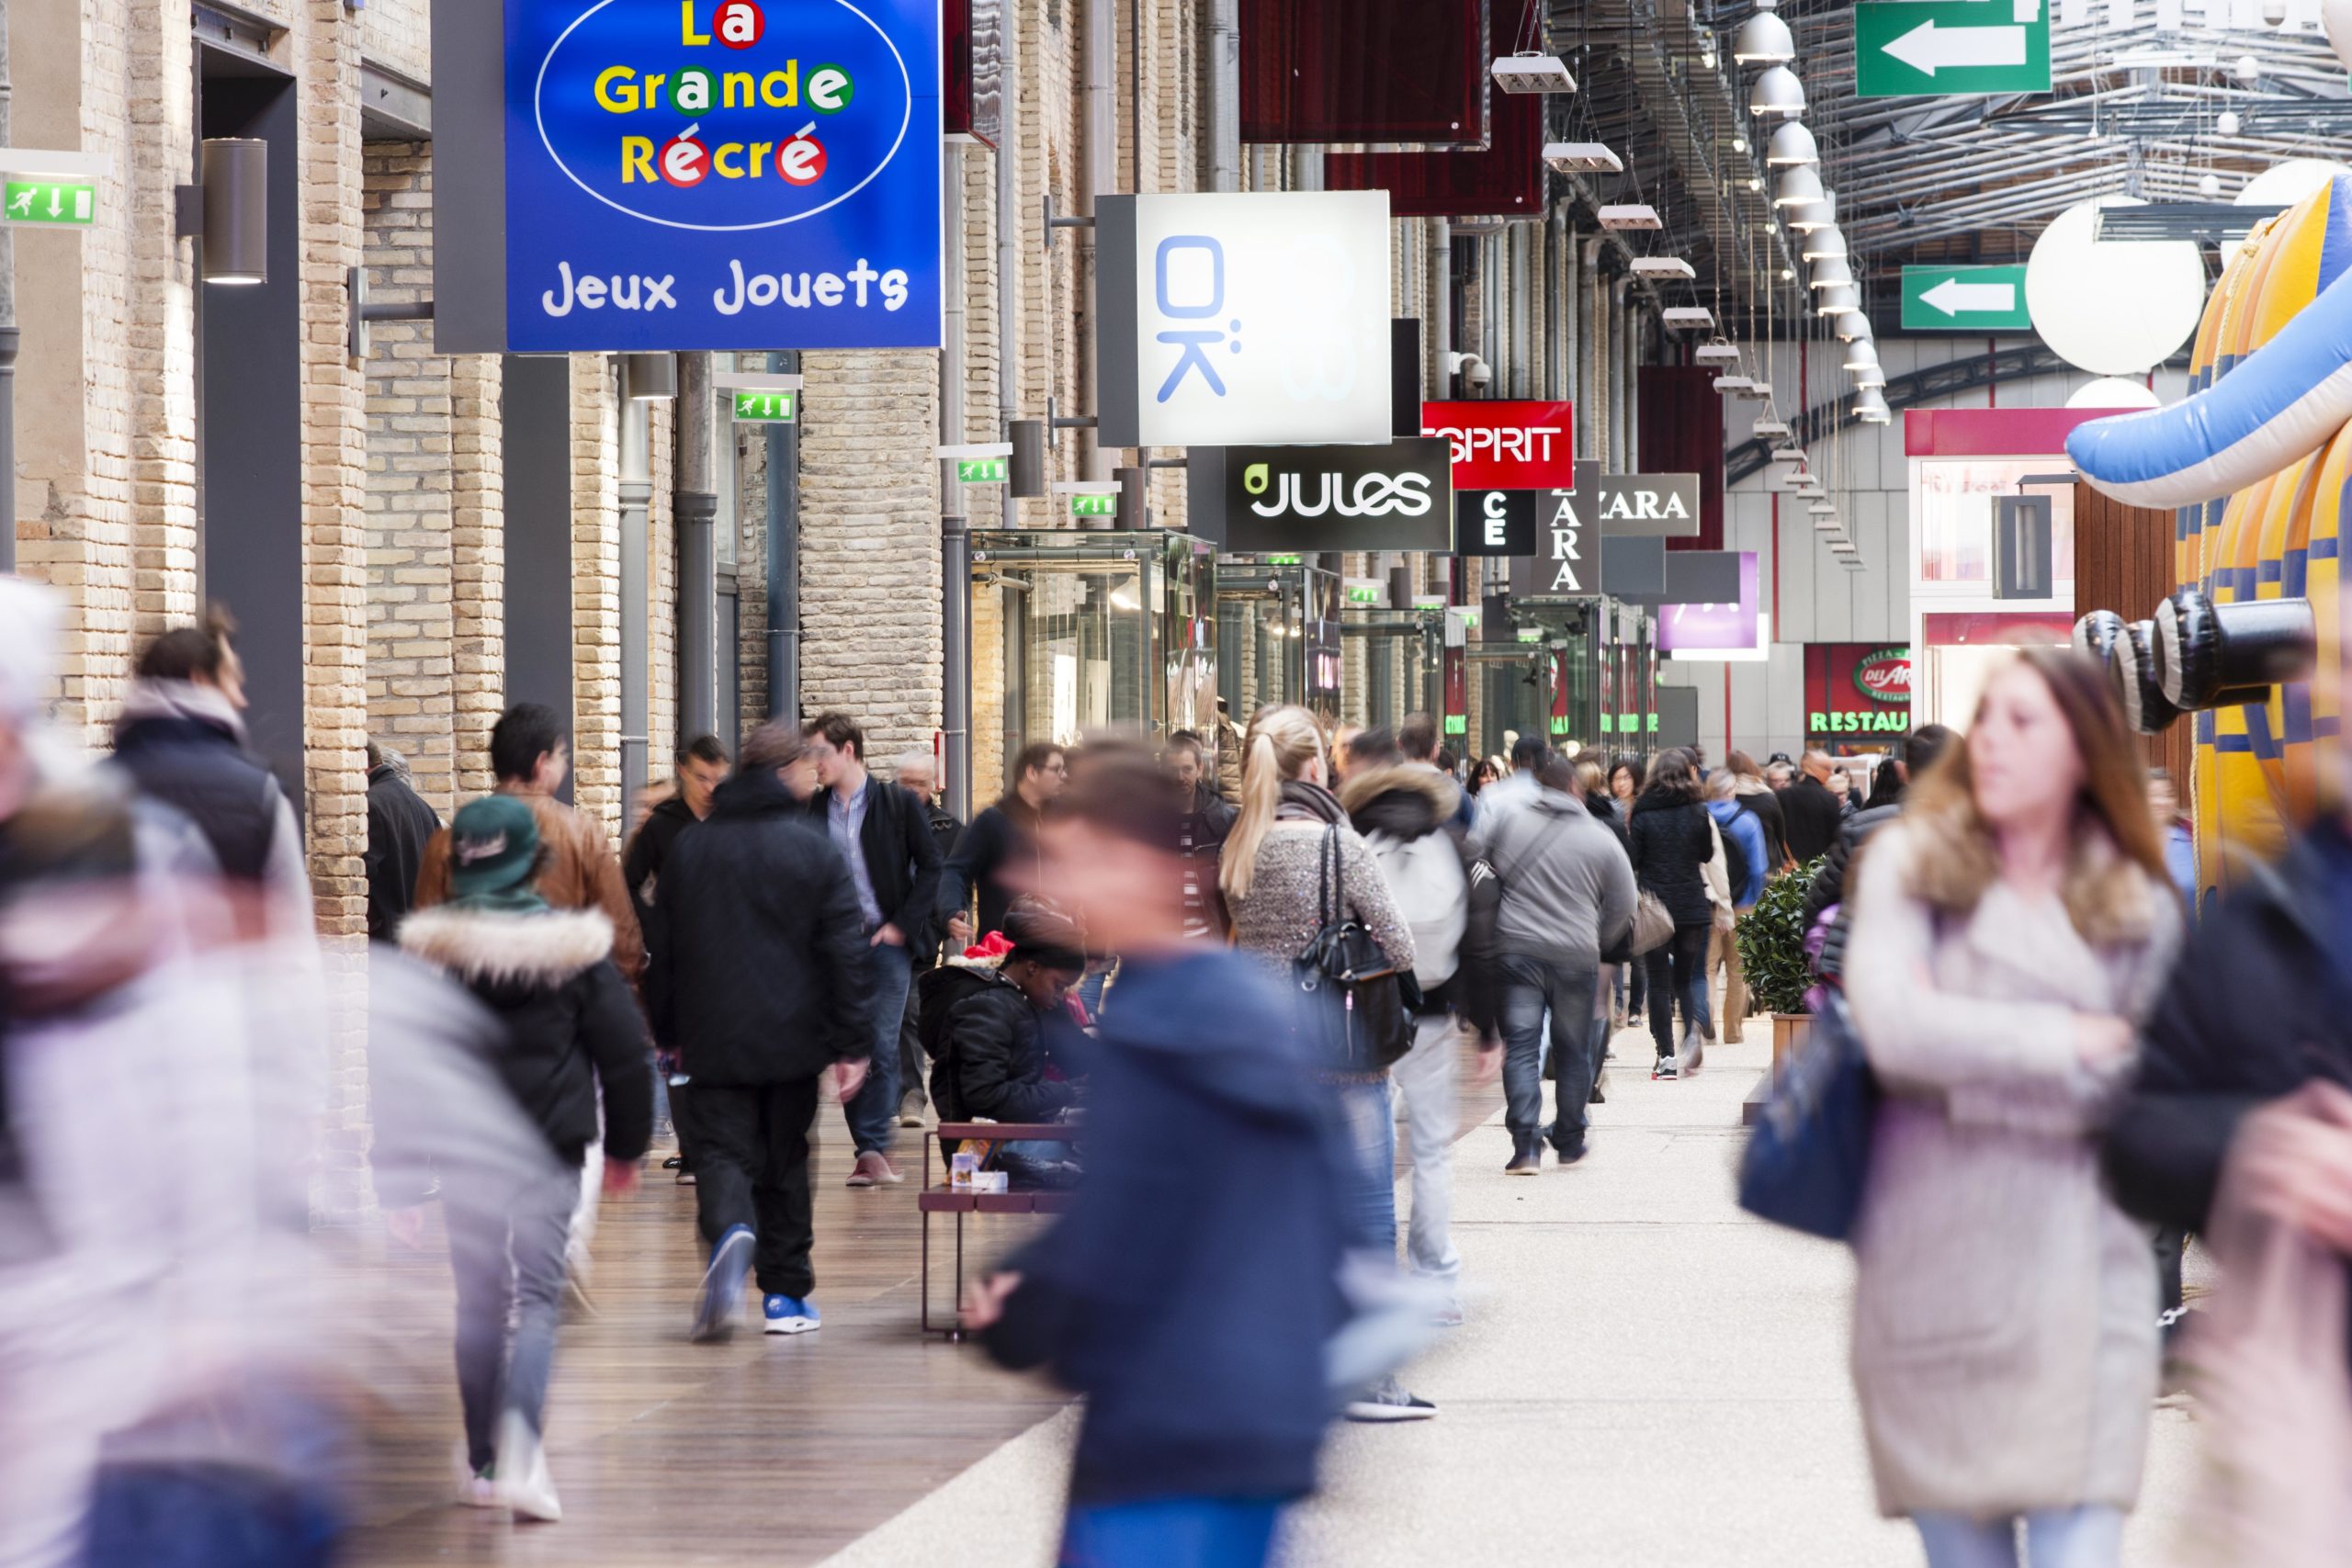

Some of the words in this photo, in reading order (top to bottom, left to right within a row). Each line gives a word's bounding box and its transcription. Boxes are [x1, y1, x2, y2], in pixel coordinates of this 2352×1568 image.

[682, 0, 755, 46] La
[594, 59, 849, 114] Grande
[621, 120, 822, 184] Récré
[541, 260, 677, 317] Jeux
[713, 257, 909, 315] Jouets
